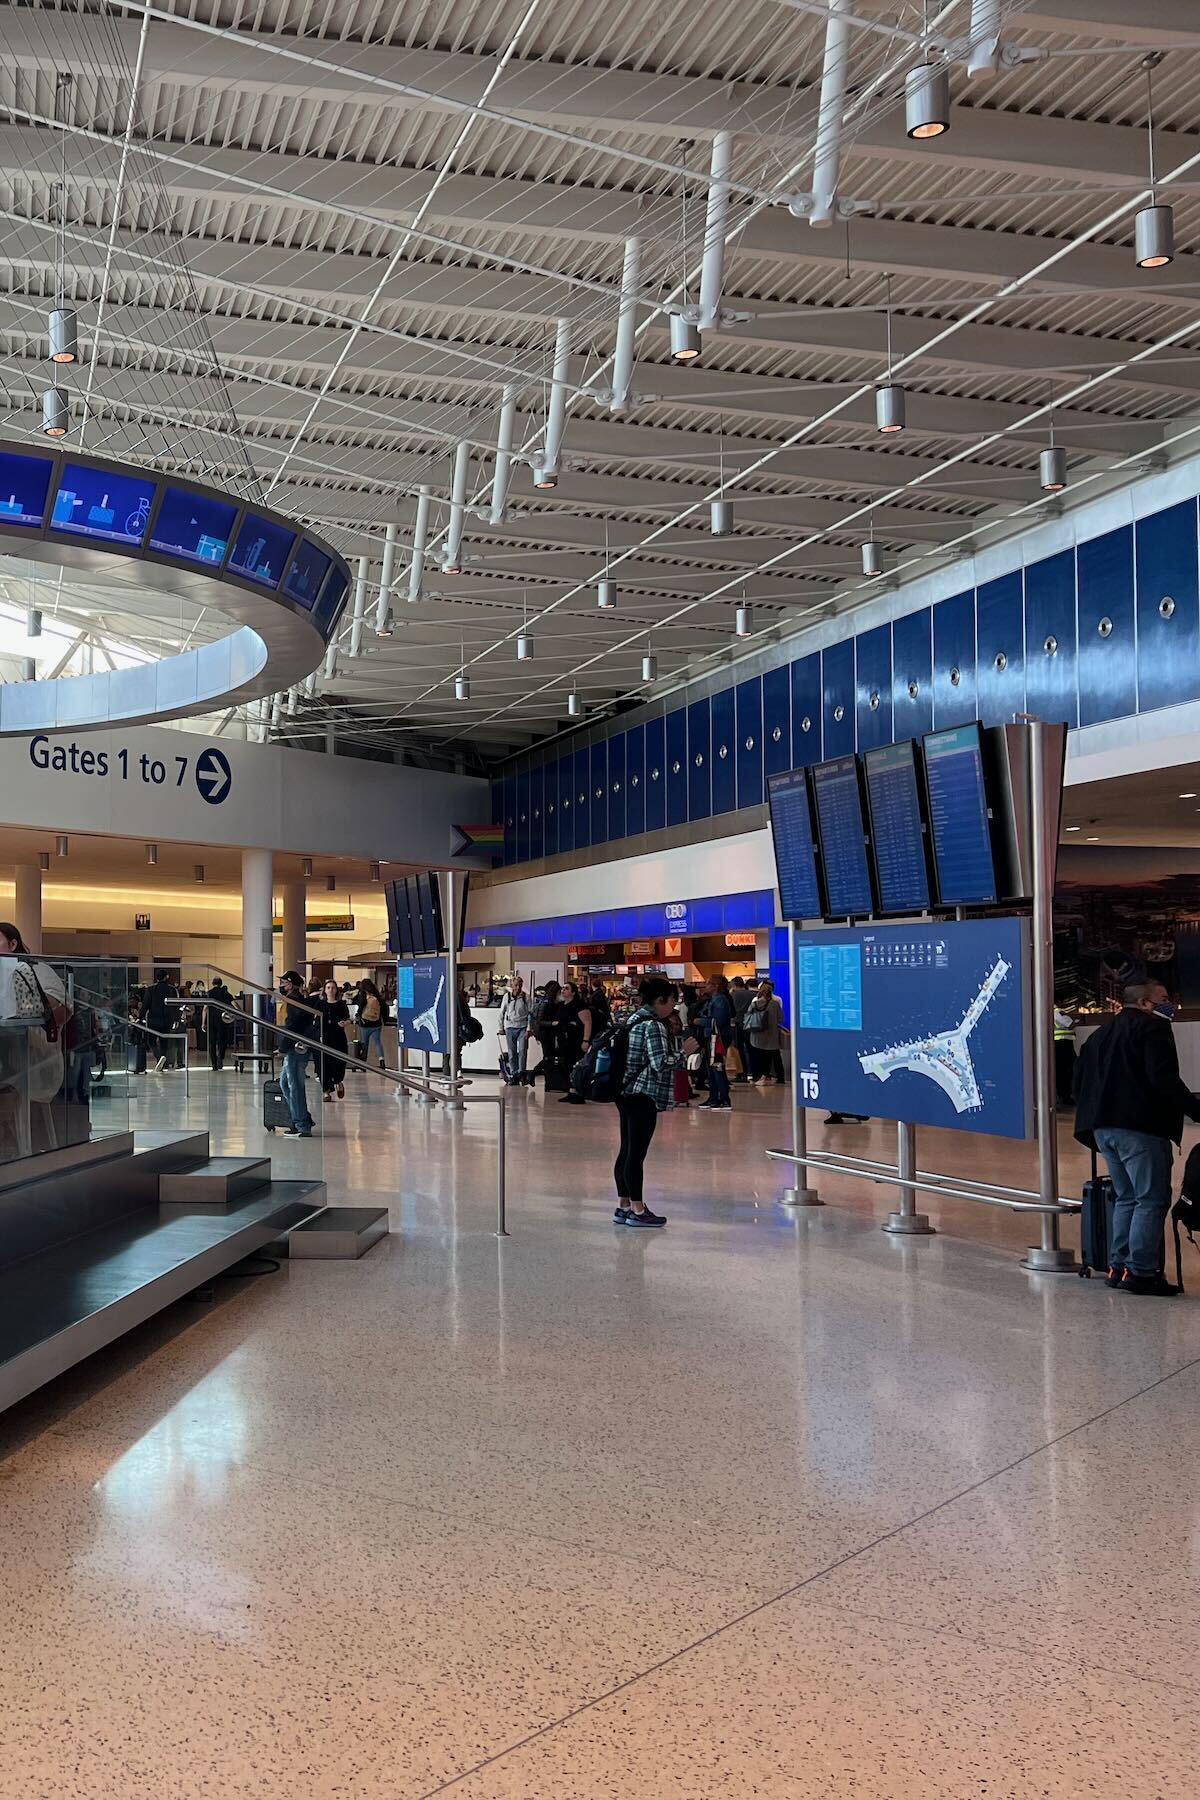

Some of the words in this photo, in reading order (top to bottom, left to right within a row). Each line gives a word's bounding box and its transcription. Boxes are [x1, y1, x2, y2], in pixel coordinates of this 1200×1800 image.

[30, 736, 109, 776] Gates
[118, 749, 128, 780] 1
[139, 753, 166, 784] to
[175, 757, 188, 786] 7
[800, 1072, 820, 1100] T5
